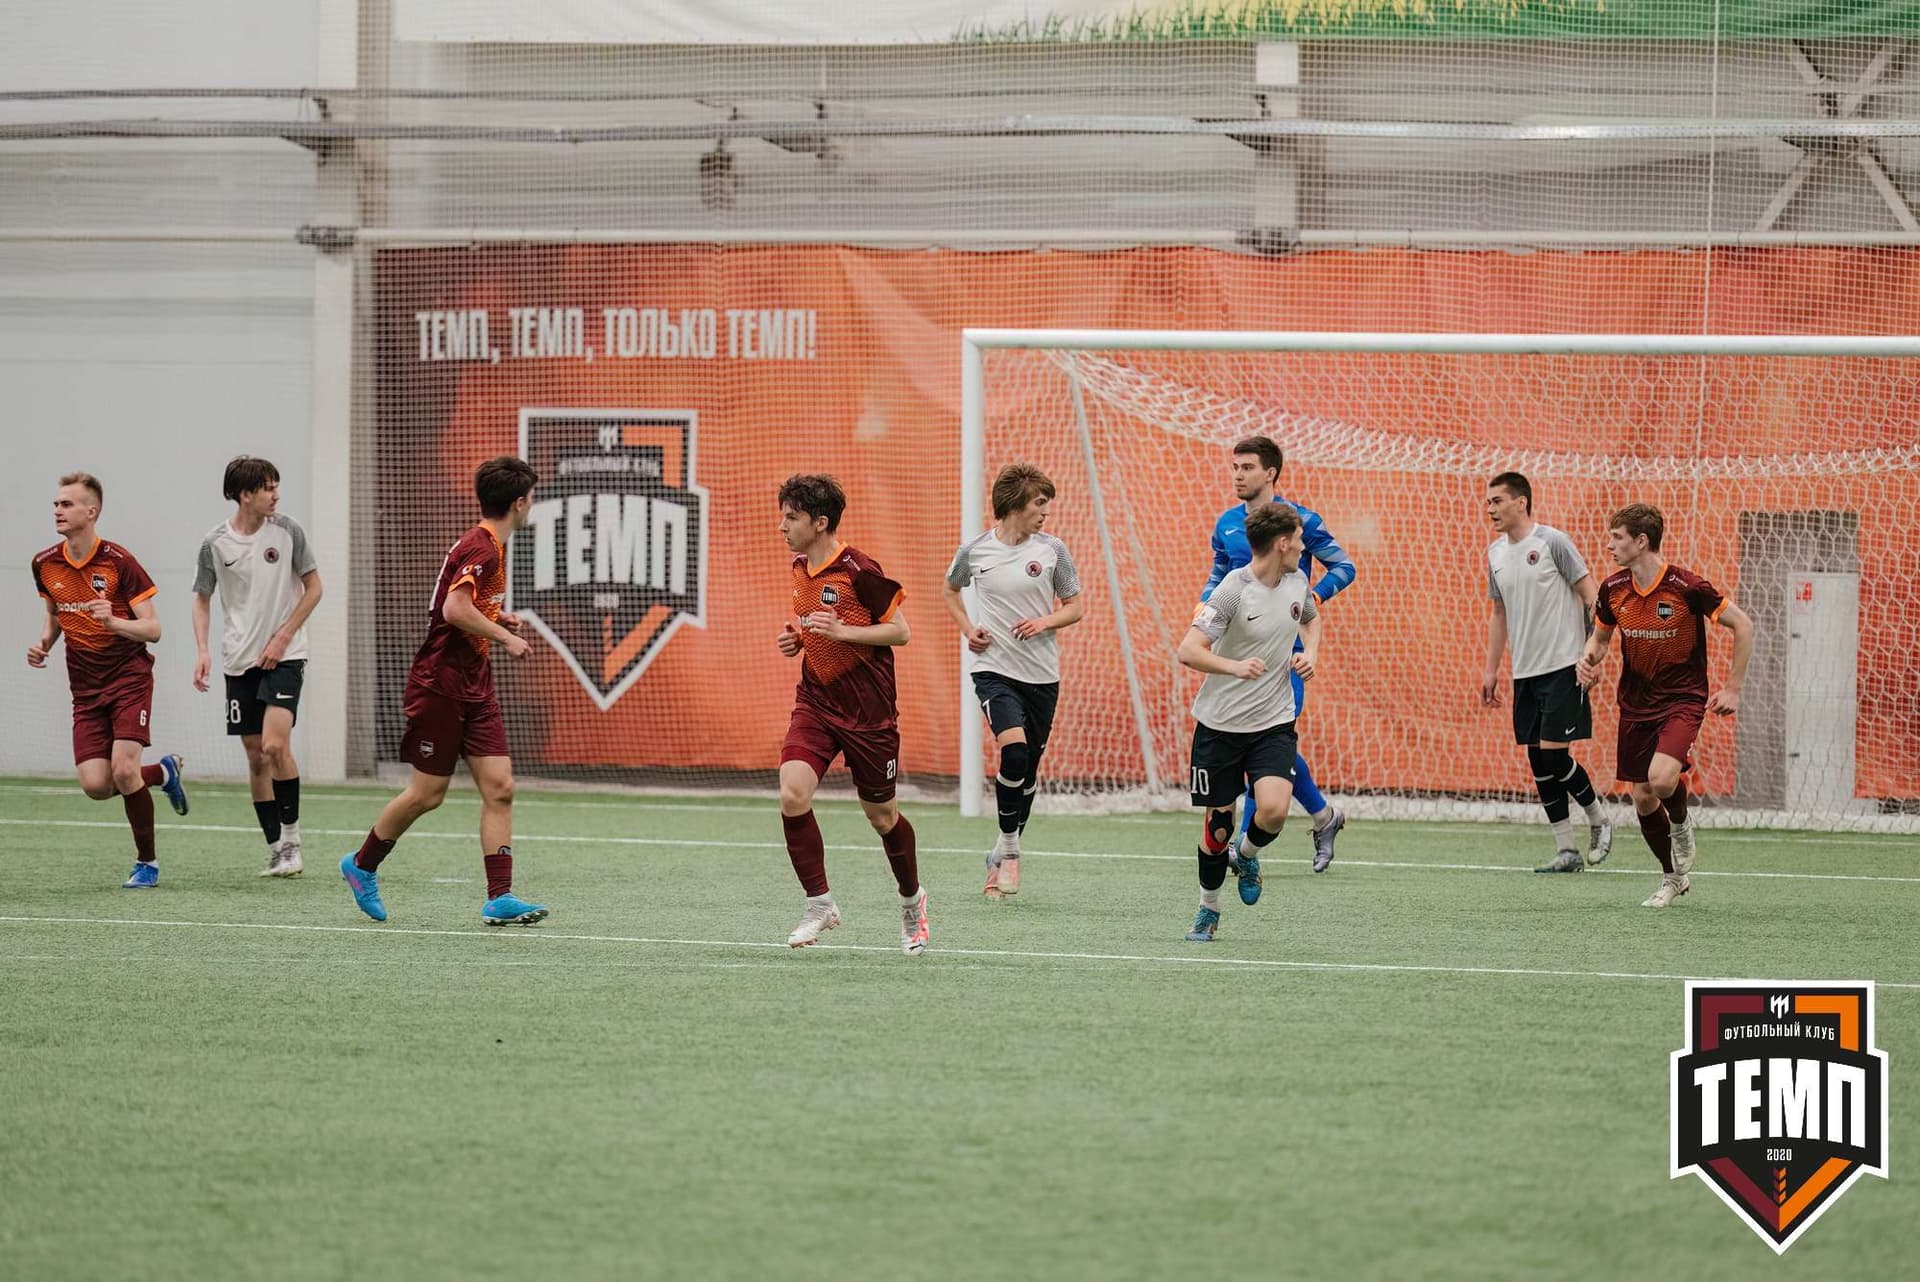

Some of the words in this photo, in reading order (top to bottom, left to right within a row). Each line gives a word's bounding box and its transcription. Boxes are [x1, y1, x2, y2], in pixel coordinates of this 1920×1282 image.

[415, 310, 500, 365] ТЕМП,
[508, 307, 594, 363] ТЕМП,
[603, 308, 716, 358] ТОЛЬКО
[726, 309, 816, 359] ТЕМП!
[528, 494, 687, 595] ТЕМП
[139, 709, 147, 726] 6
[886, 758, 897, 780] 21
[1190, 766, 1210, 796] 10
